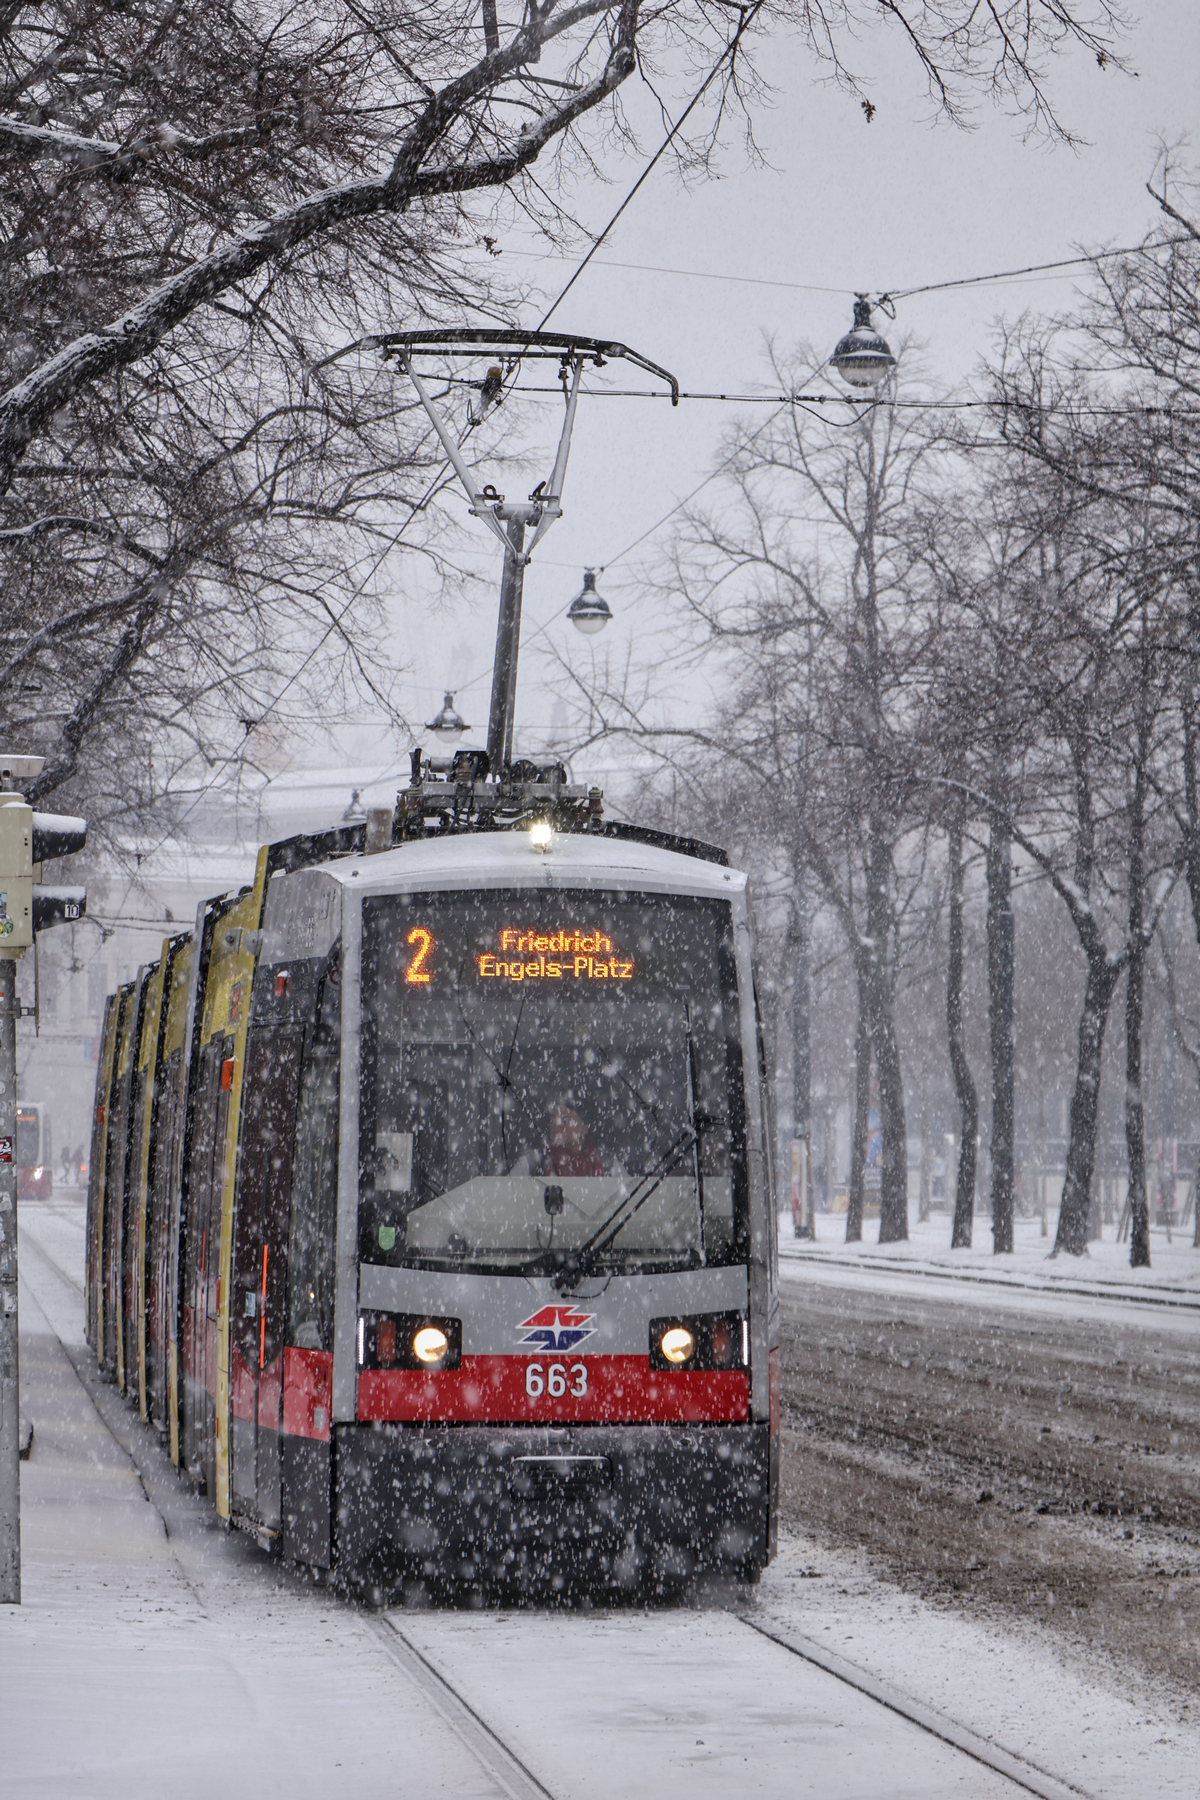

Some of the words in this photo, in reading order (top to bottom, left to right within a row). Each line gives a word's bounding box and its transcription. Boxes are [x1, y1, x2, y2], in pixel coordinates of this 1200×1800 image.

[66, 905, 79, 917] 10
[501, 929, 611, 952] Friedrich
[406, 929, 431, 982] 2
[478, 955, 633, 981] Engels-Platz
[525, 1362, 588, 1397] 663
